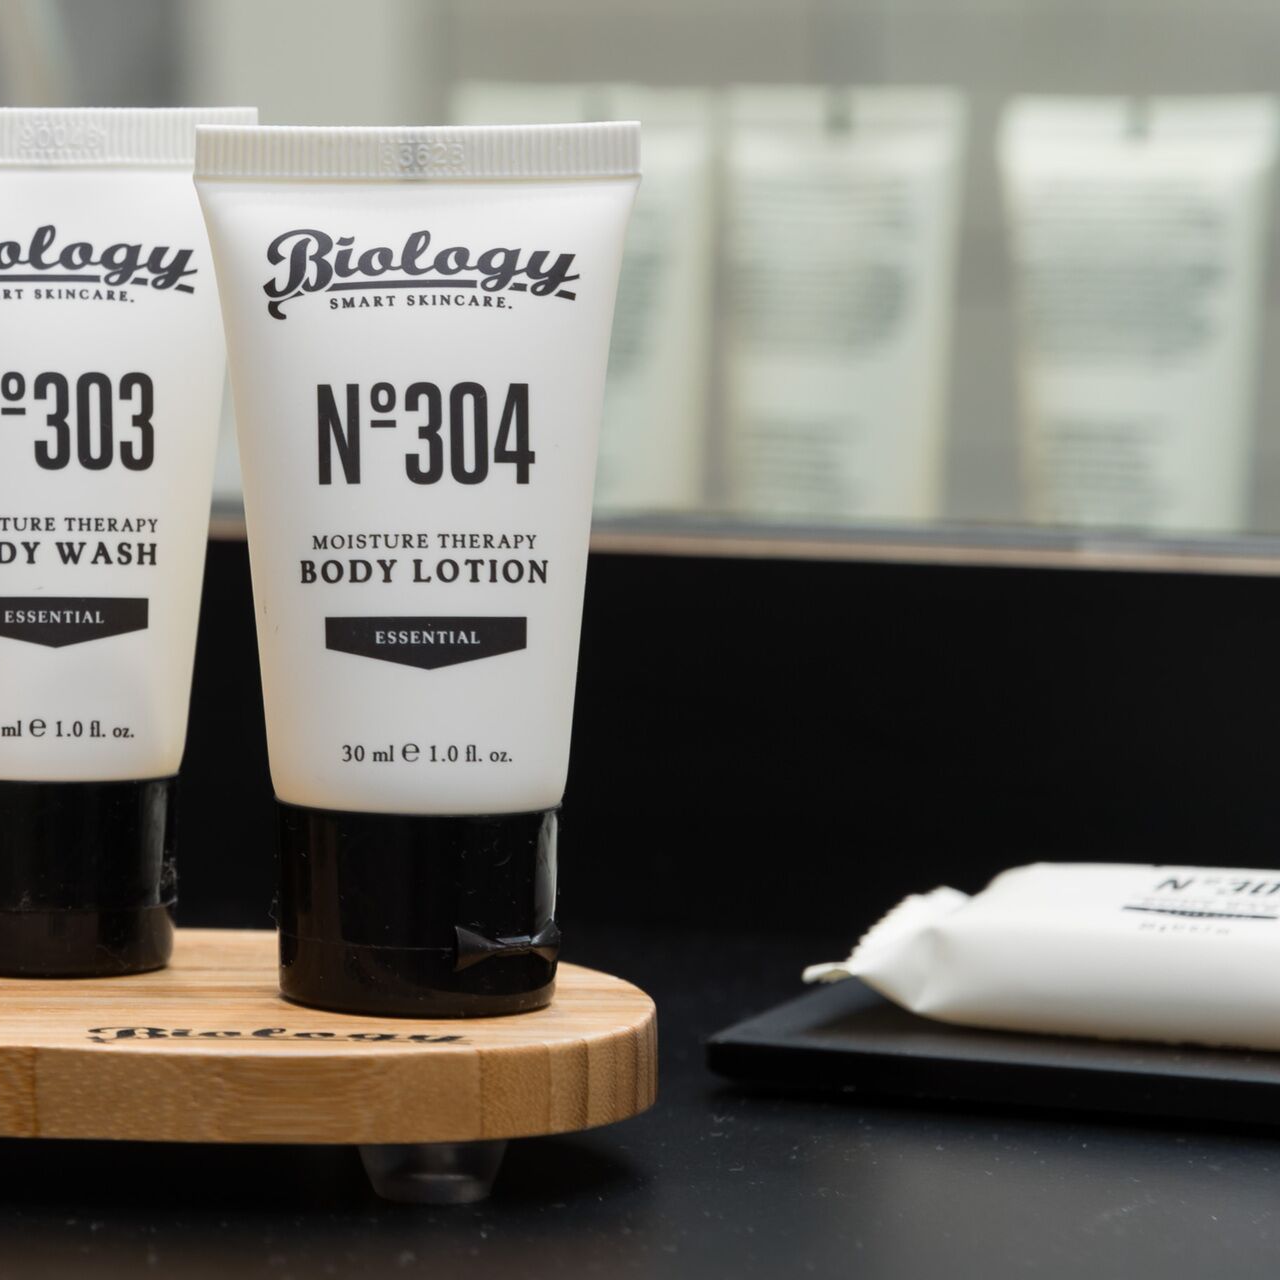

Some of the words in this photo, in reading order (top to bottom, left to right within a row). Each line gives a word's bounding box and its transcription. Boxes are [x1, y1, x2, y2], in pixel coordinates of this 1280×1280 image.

[262, 229, 580, 321] Biology
[34, 289, 135, 304] SKINCARE.
[329, 295, 396, 310] SMART
[406, 294, 513, 310] SKINCARE.
[63, 517, 158, 533] THERAPY
[312, 533, 429, 551] MOISTURE
[436, 533, 537, 550] THERAPY
[54, 541, 157, 566] WASH
[299, 558, 398, 585] BODY
[412, 558, 549, 584] LOTION
[4, 610, 105, 624] ESSENTIAL
[375, 630, 481, 645] ESSENTIAL
[1, 719, 22, 738] ml
[55, 720, 84, 738] 1.0
[89, 719, 107, 738] fl.
[112, 726, 135, 739] oz.
[341, 744, 366, 763] 30
[372, 744, 395, 763] ml
[429, 744, 459, 763] 1.0
[465, 744, 483, 763] fl.
[489, 751, 513, 763] oz.
[86, 1026, 472, 1044] Biology
